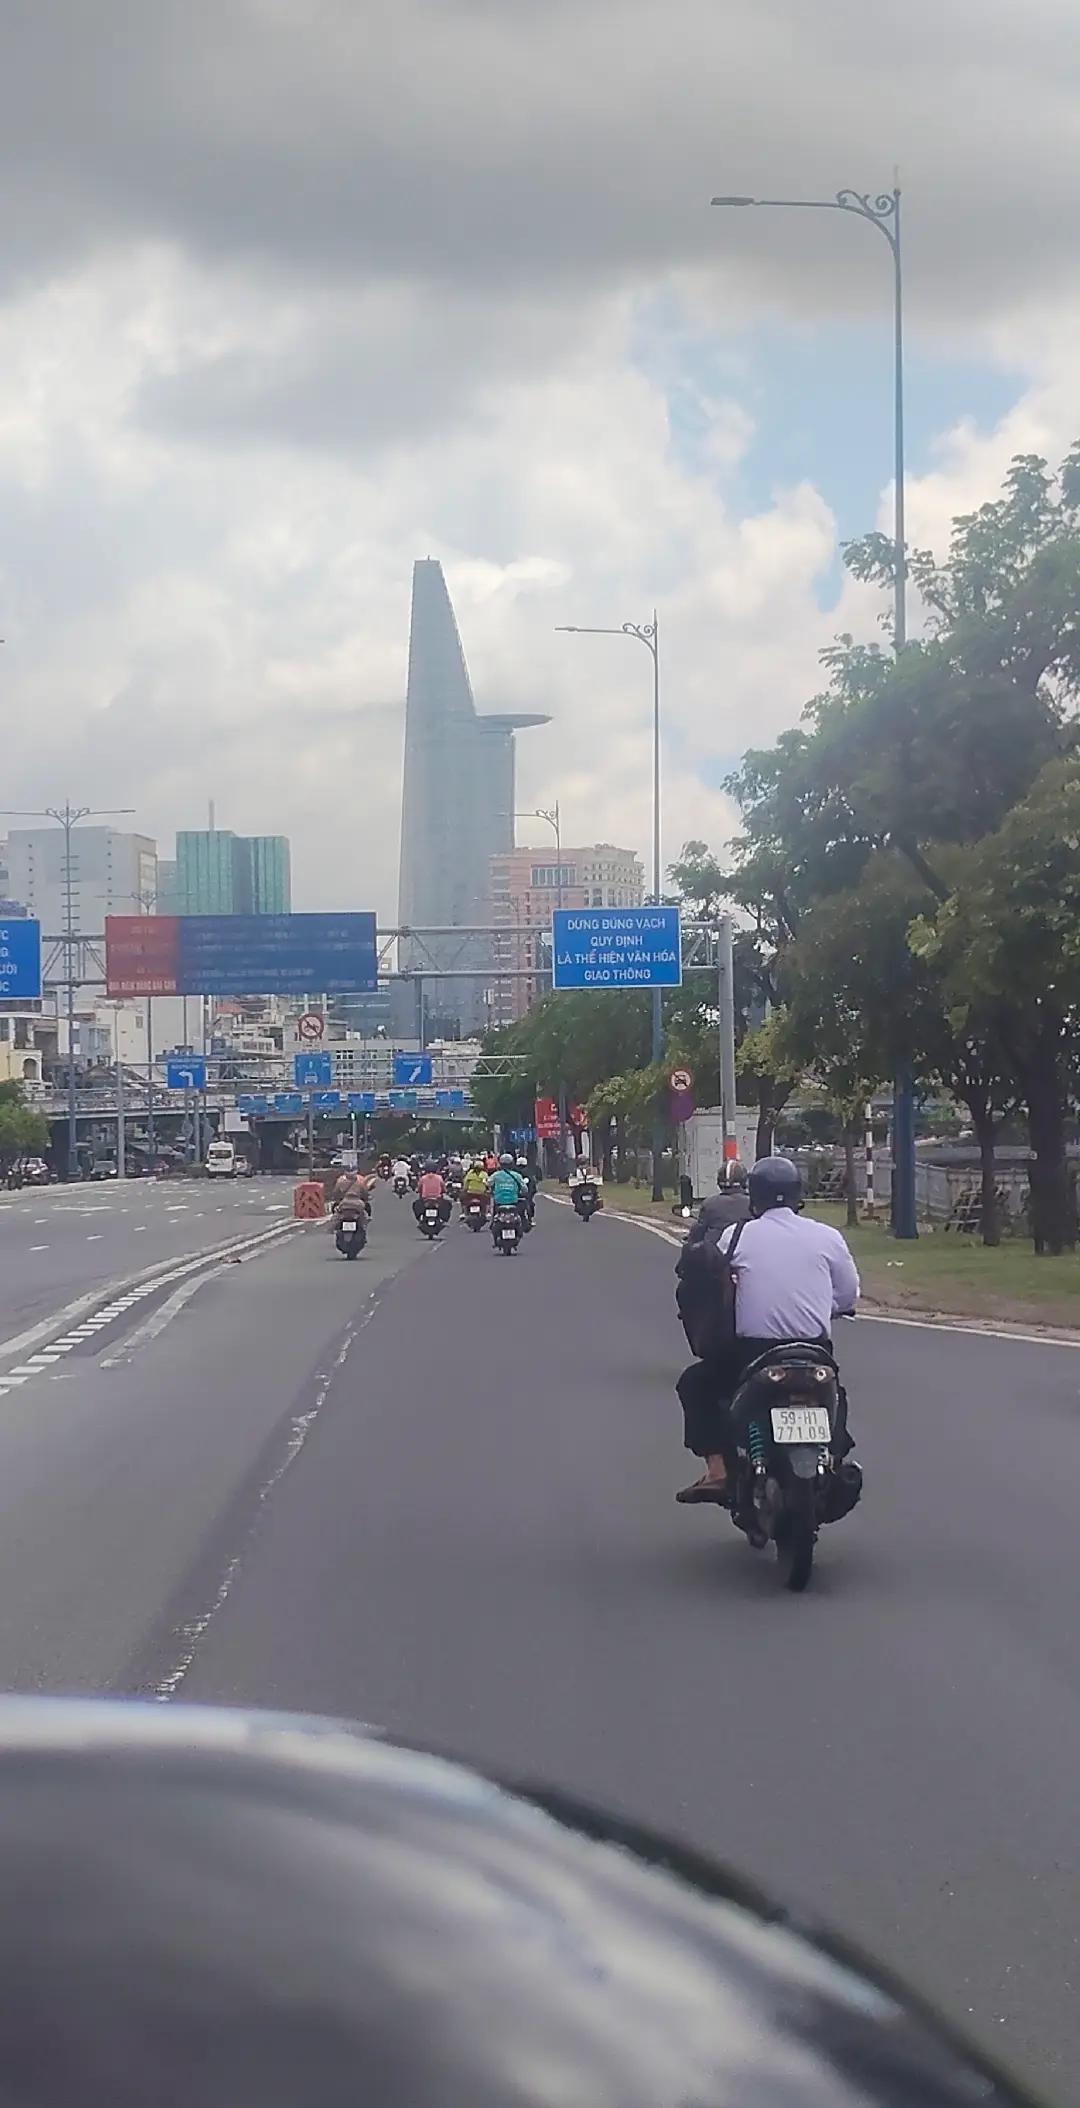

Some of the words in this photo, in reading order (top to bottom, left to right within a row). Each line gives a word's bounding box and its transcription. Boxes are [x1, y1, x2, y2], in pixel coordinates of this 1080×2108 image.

[590, 936, 613, 947] QUY
[616, 935, 643, 947] ĐỊNH
[557, 953, 572, 965] LÀ
[574, 948, 597, 964] THỂ
[598, 952, 625, 964] HIỆN
[627, 951, 651, 963] VĂN
[653, 949, 676, 962] HÓA
[584, 970, 610, 981] GIAO
[612, 967, 651, 980] THÔNG
[780, 1411, 817, 1424] 59-H1
